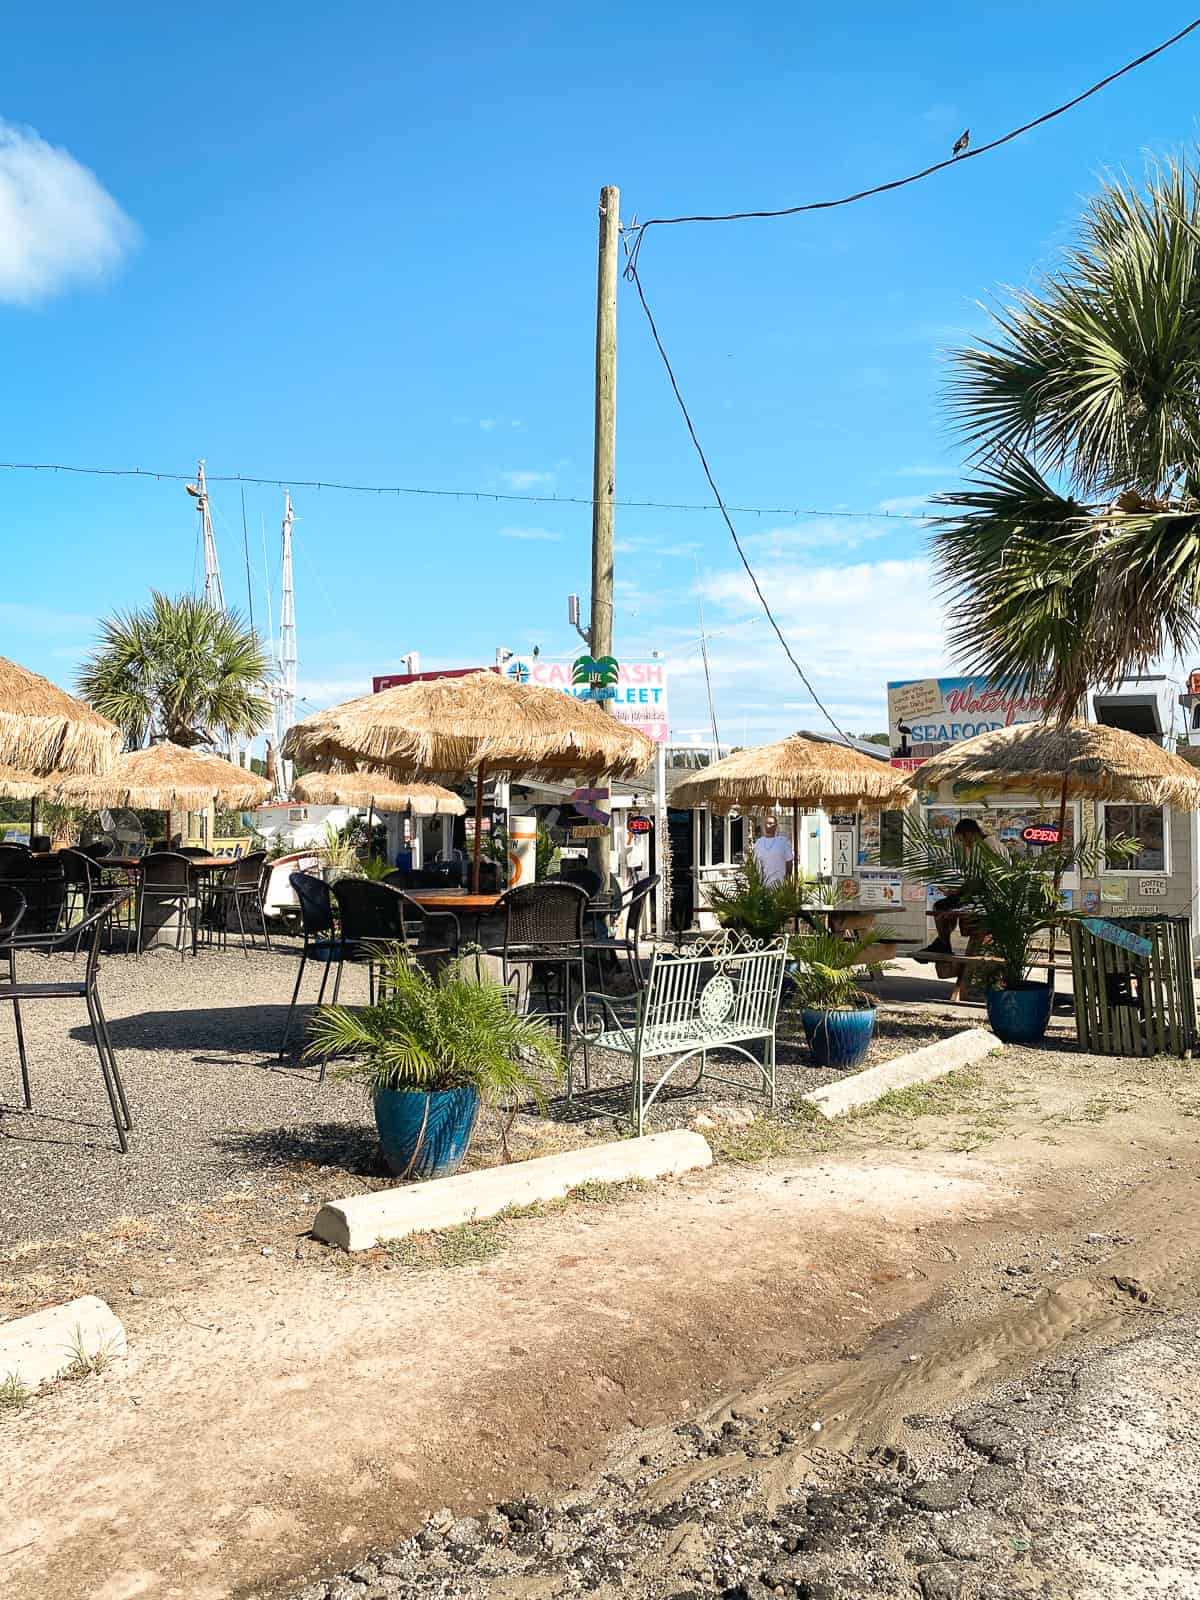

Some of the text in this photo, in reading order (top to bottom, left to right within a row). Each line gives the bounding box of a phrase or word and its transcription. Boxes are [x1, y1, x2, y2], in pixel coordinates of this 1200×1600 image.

[532, 664, 662, 683] CAASH
[613, 687, 663, 703] LEET
[1023, 828, 1060, 842] OPEN
[837, 839, 849, 874] EAT
